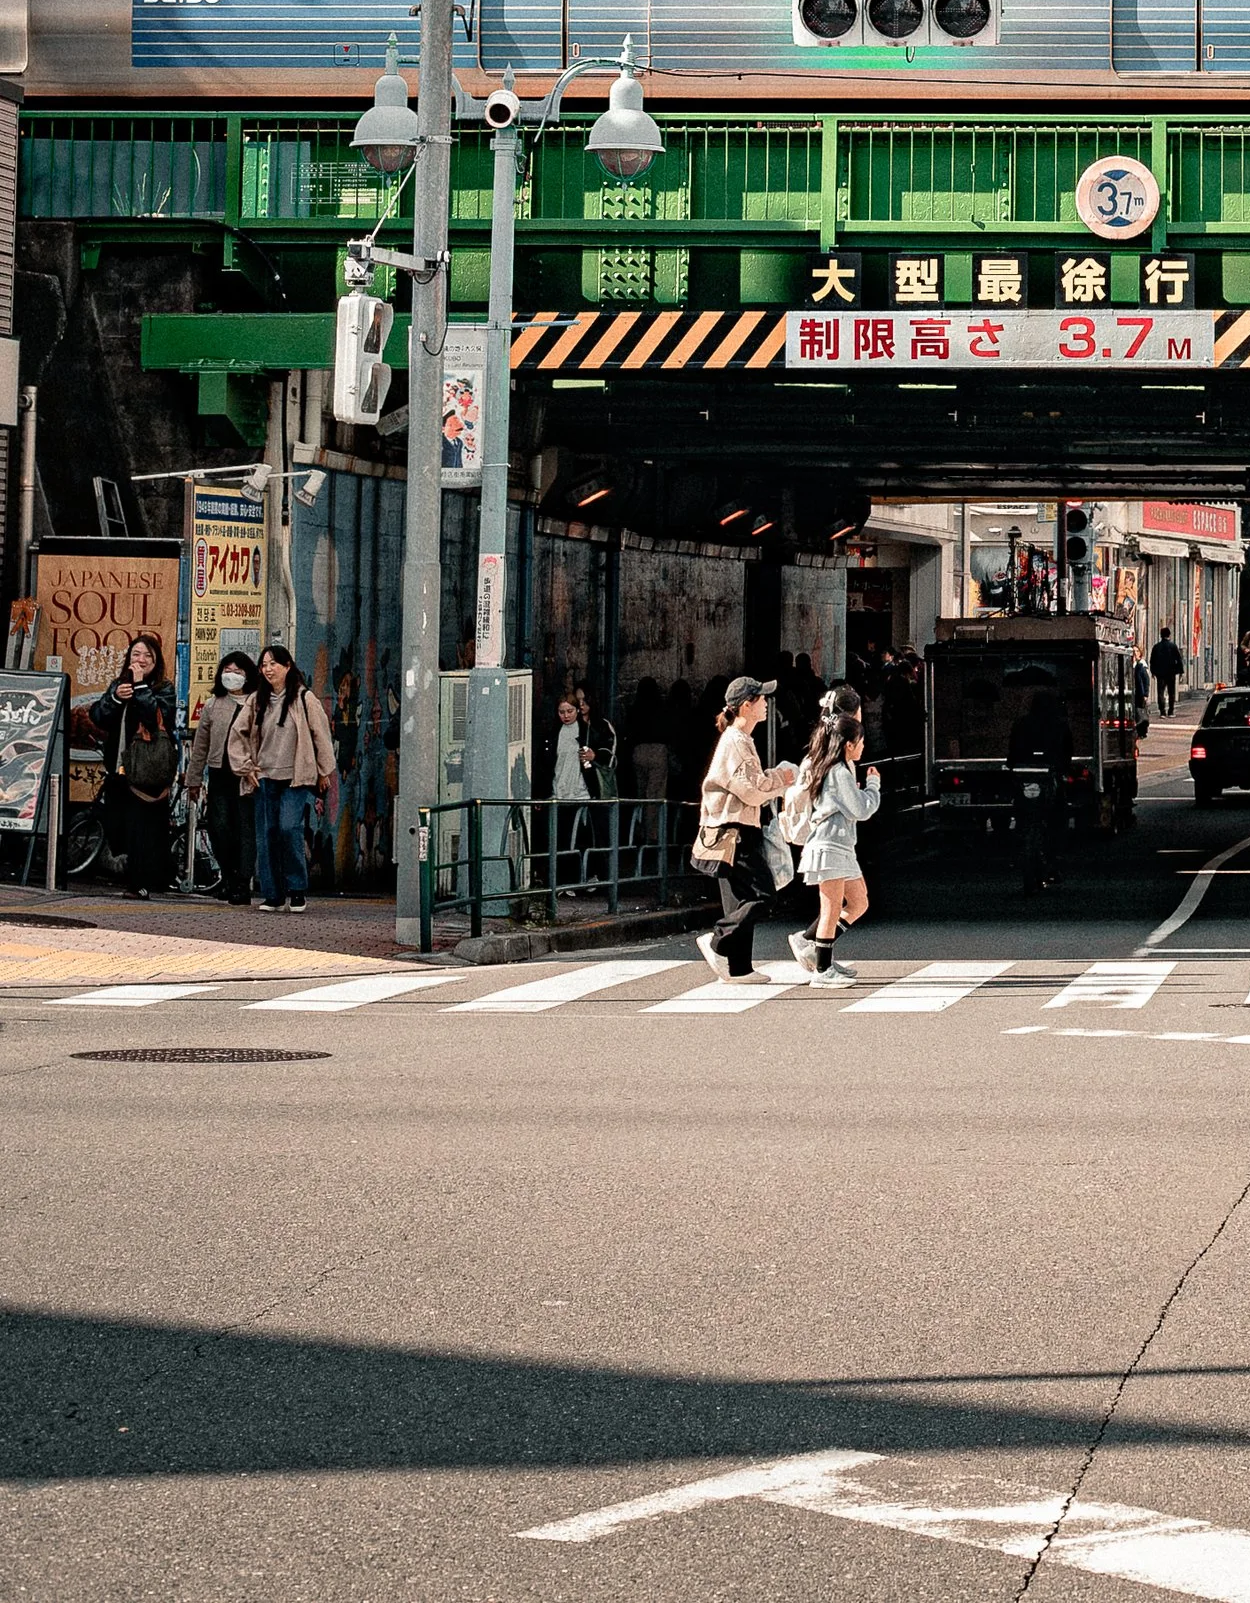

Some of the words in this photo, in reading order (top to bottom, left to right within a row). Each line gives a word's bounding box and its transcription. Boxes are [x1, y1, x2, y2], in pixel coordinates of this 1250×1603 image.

[811, 257, 1191, 304] 大型最徐行
[799, 317, 1005, 361] 制限高さ
[50, 570, 164, 590] JAPANESE
[208, 543, 251, 585] アイカワ
[50, 589, 162, 626] SOUL
